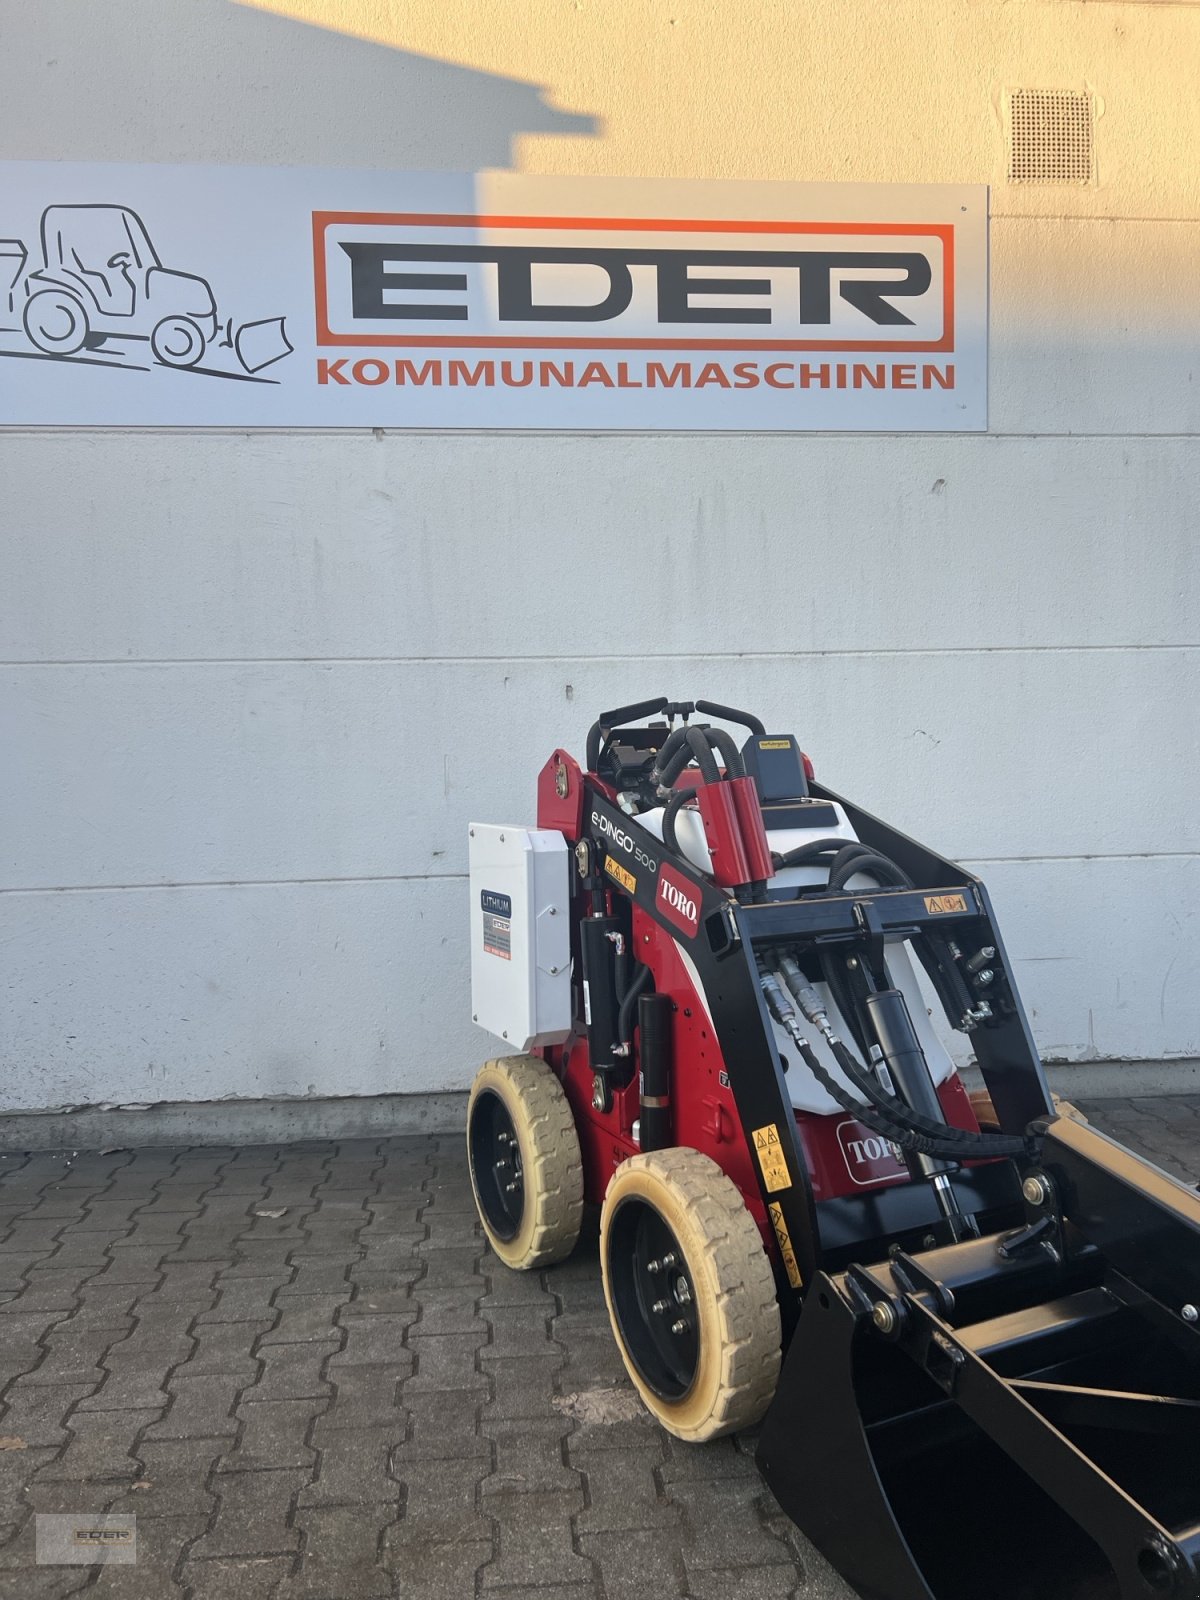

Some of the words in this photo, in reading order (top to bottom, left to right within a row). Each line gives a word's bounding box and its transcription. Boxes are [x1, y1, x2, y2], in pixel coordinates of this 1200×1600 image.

[337, 242, 932, 325] EDER
[316, 357, 955, 390] KOMMUNALMASCHINEN
[634, 847, 656, 873] 500
[482, 895, 511, 912] LITHIUM
[661, 878, 697, 921] TORO
